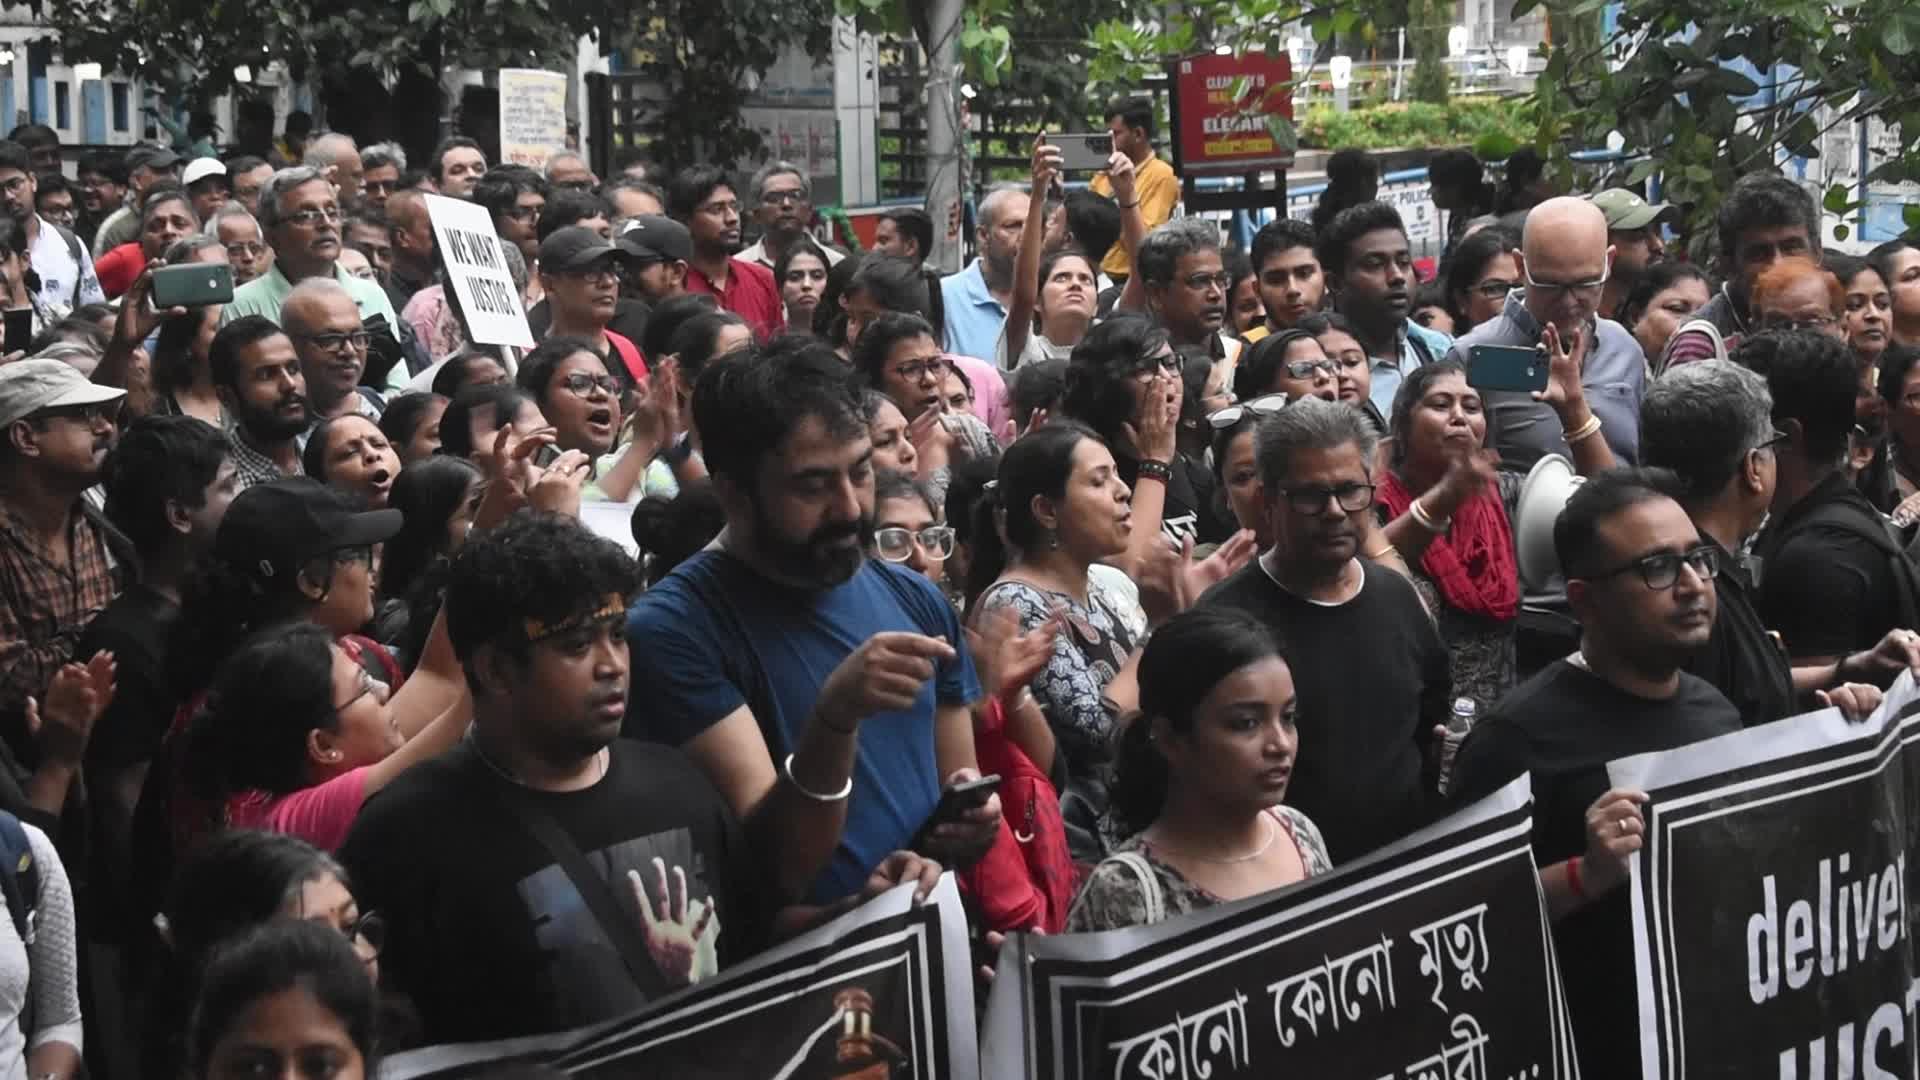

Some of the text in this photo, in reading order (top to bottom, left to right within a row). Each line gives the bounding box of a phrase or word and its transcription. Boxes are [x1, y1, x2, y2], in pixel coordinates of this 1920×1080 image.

[443, 227, 502, 271] WE WANT
[465, 275, 516, 316] JUSTICE
[1267, 931, 1395, 1048] কোনো
[1409, 902, 1489, 1014] মৃত্যু
